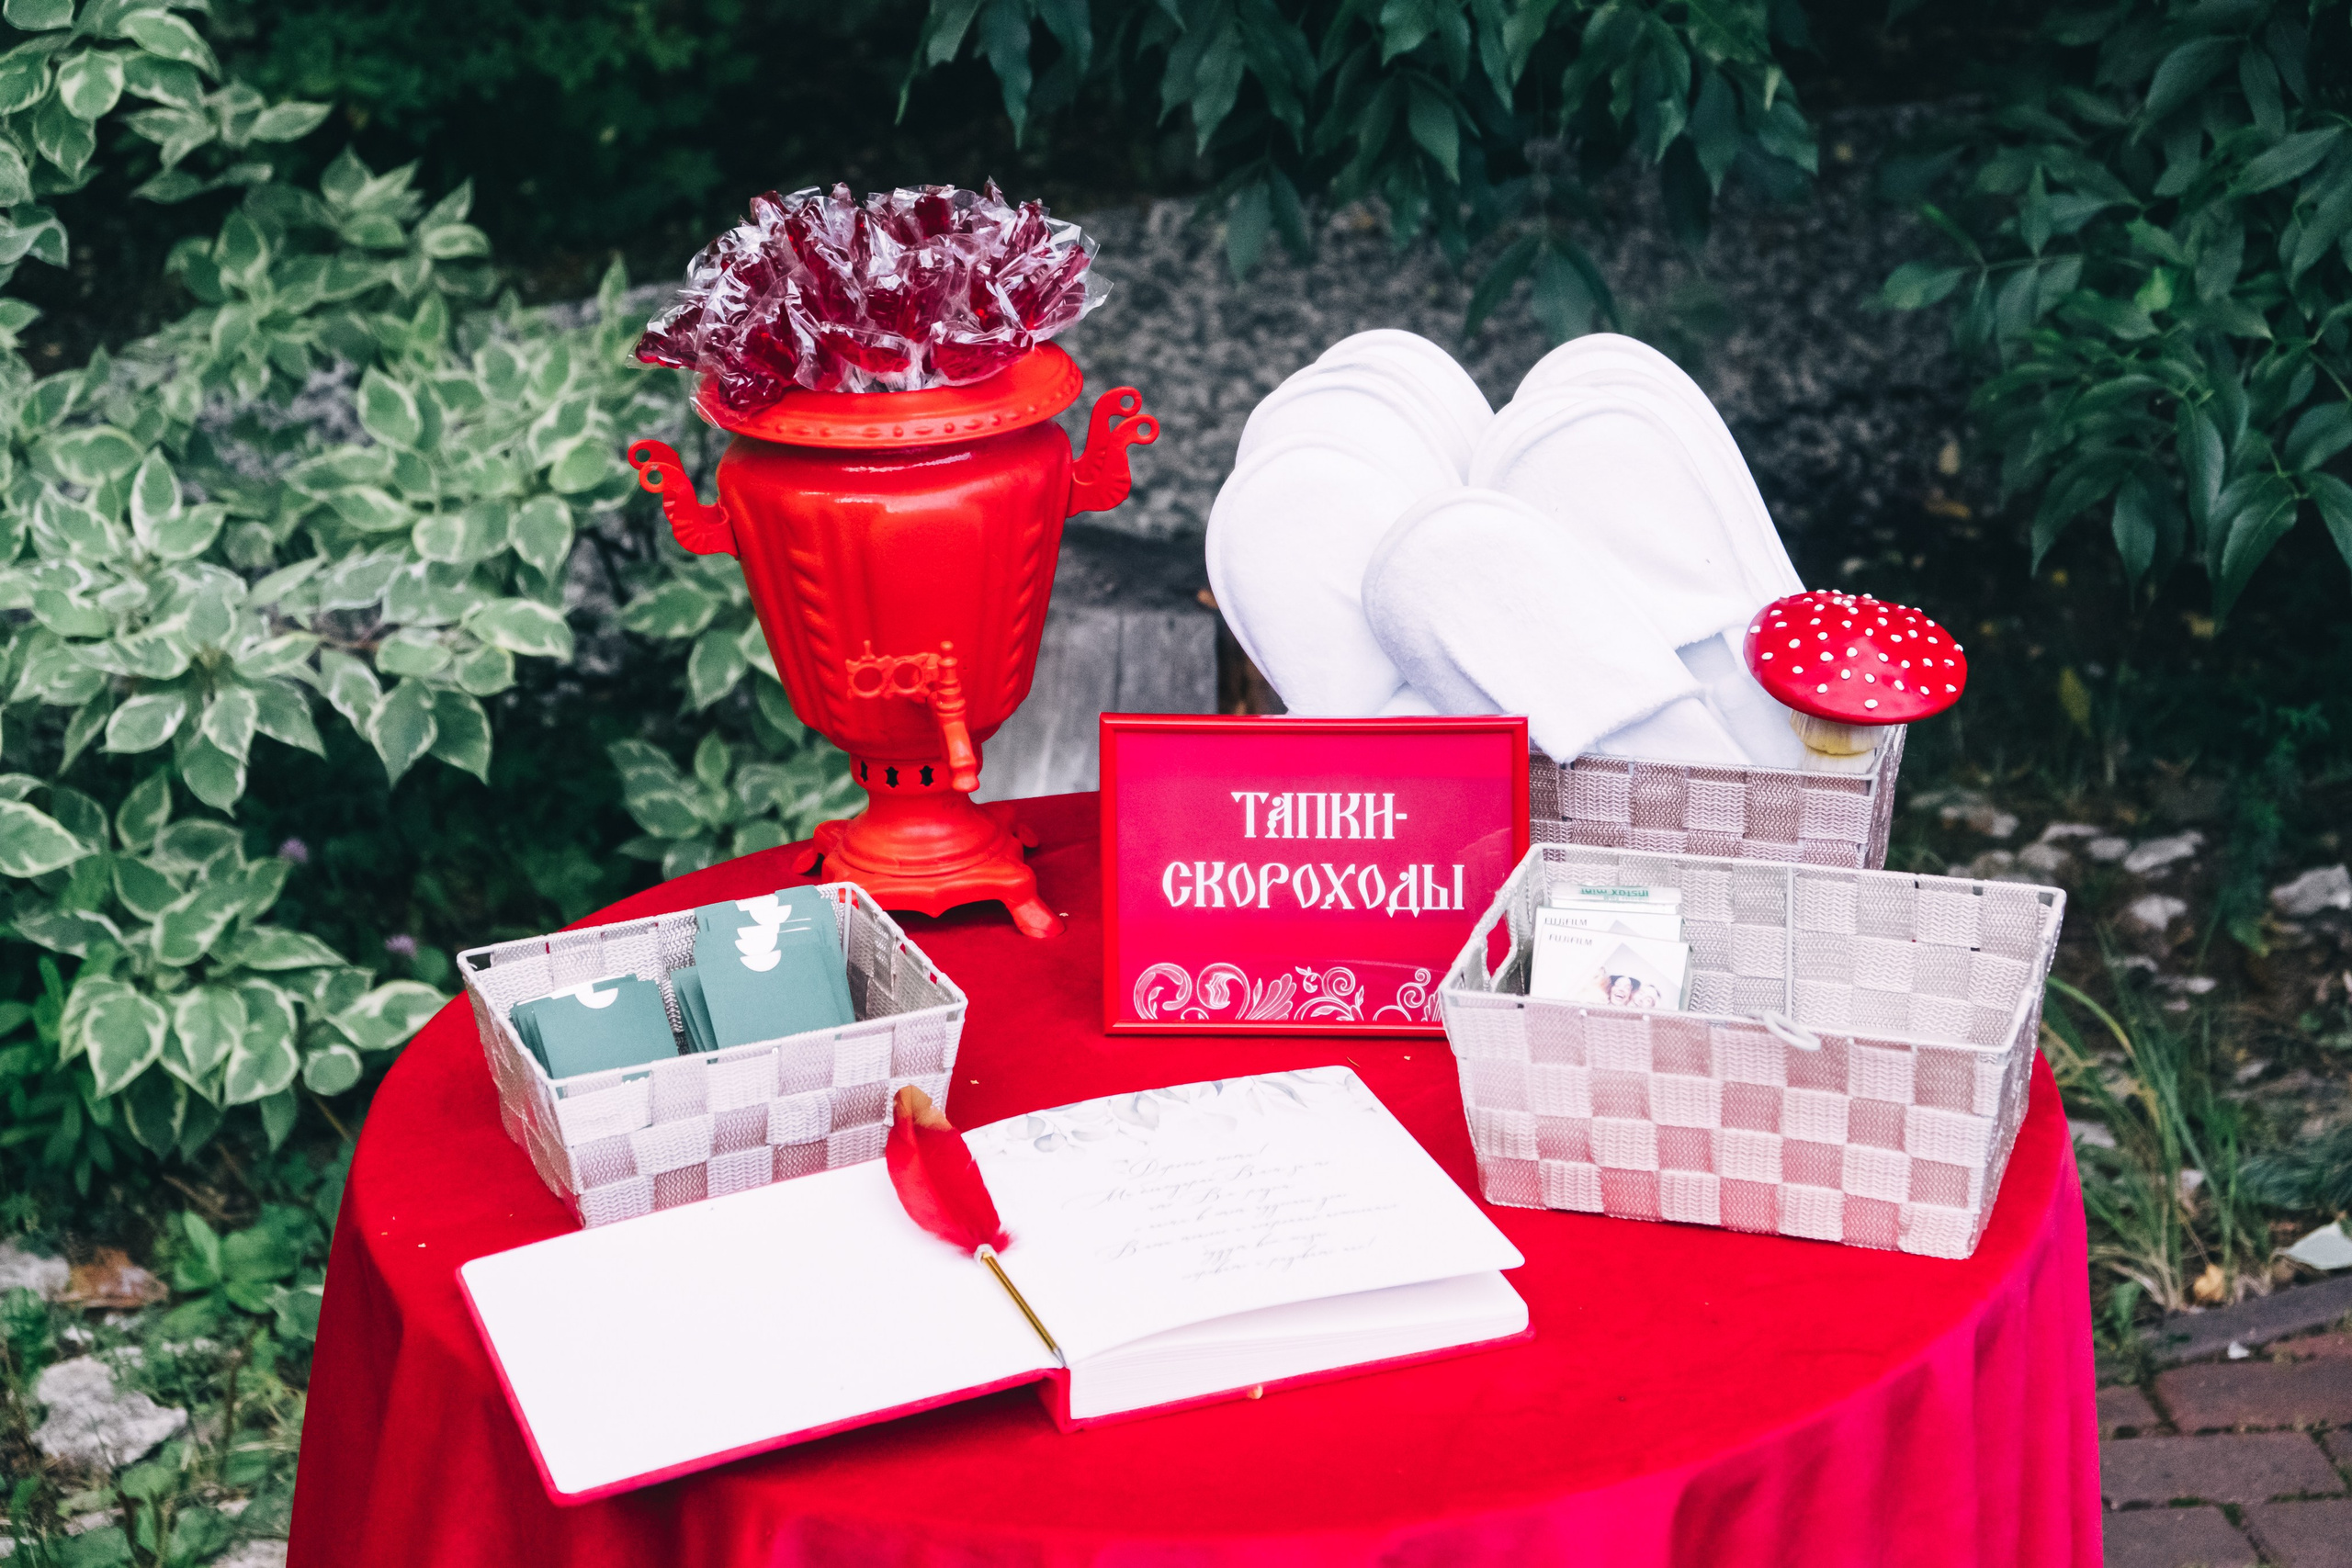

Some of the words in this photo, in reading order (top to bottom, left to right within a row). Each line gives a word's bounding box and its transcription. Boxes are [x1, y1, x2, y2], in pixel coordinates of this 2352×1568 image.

[1161, 861, 1465, 919] СКОРОХОДЫ
[1544, 917, 1588, 927] FUJIFILM
[1549, 933, 1593, 946] FUJIFILM
